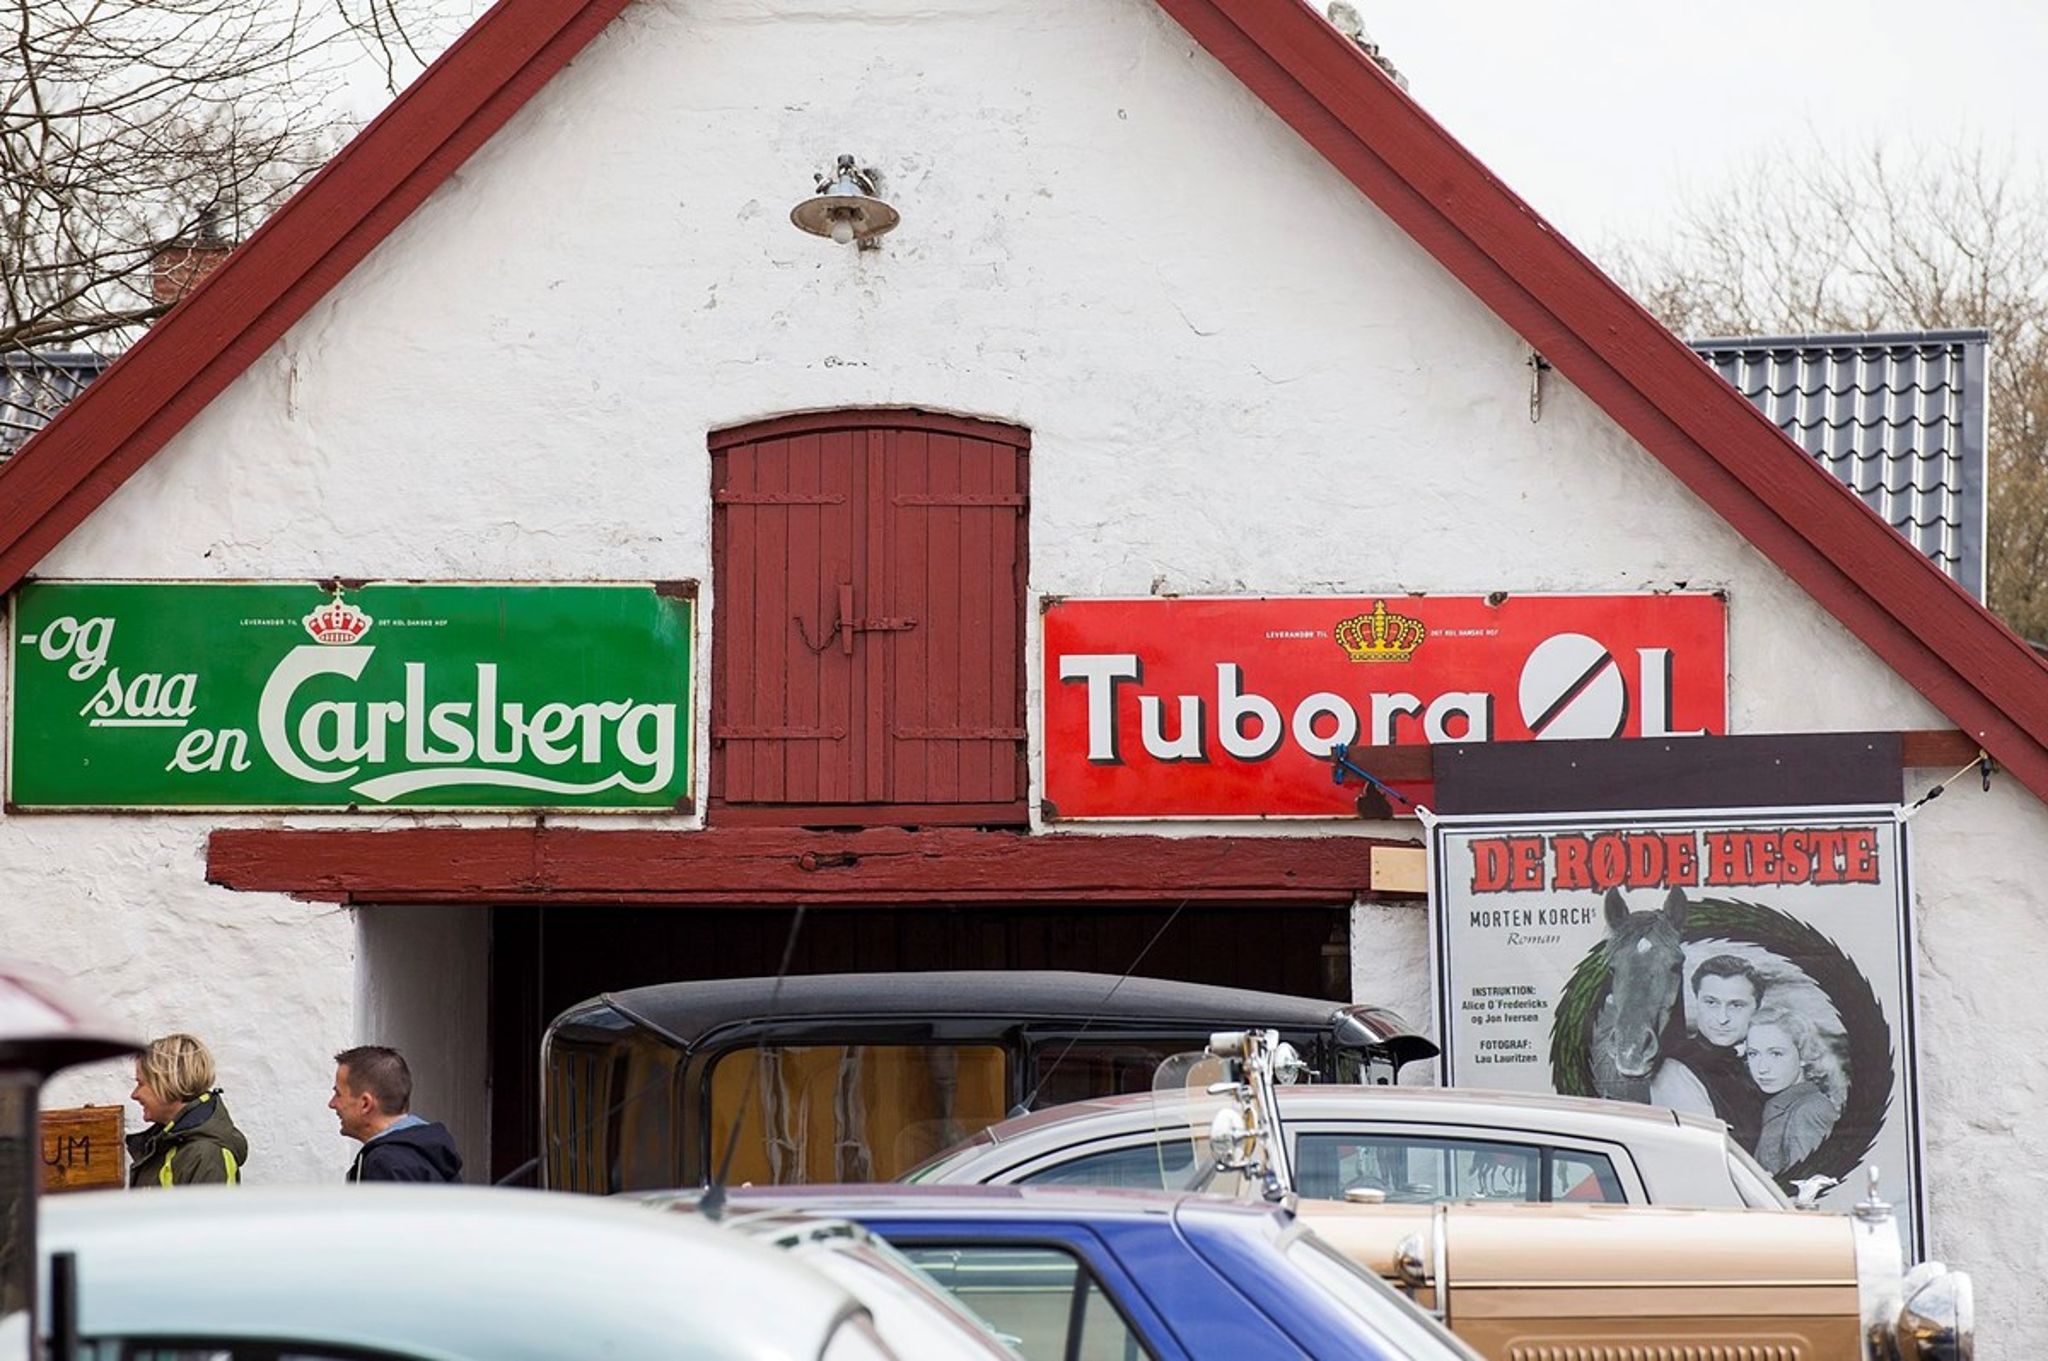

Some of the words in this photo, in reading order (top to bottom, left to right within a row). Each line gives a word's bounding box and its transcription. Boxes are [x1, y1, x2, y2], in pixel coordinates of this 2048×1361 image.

[79, 668, 197, 727] saa
[258, 645, 676, 803] Carlsberg
[165, 729, 250, 772] en
[1469, 834, 1545, 894] DE
[1551, 829, 1699, 894] RØDE
[1703, 827, 1881, 886] HESTE
[1470, 909, 1532, 928] MORTEN
[1507, 932, 1561, 946] Roman
[1472, 986, 1537, 997] INSTRUKTION:
[1462, 1000, 1485, 1010] Alice
[1471, 1016, 1483, 1025] og
[1485, 1014, 1502, 1023] Jon
[1504, 1013, 1539, 1022] Iversen
[1480, 1039, 1533, 1050] FOTOGRAF:
[1475, 1054, 1492, 1063] Lau
[1494, 1053, 1538, 1063] Lauritzen
